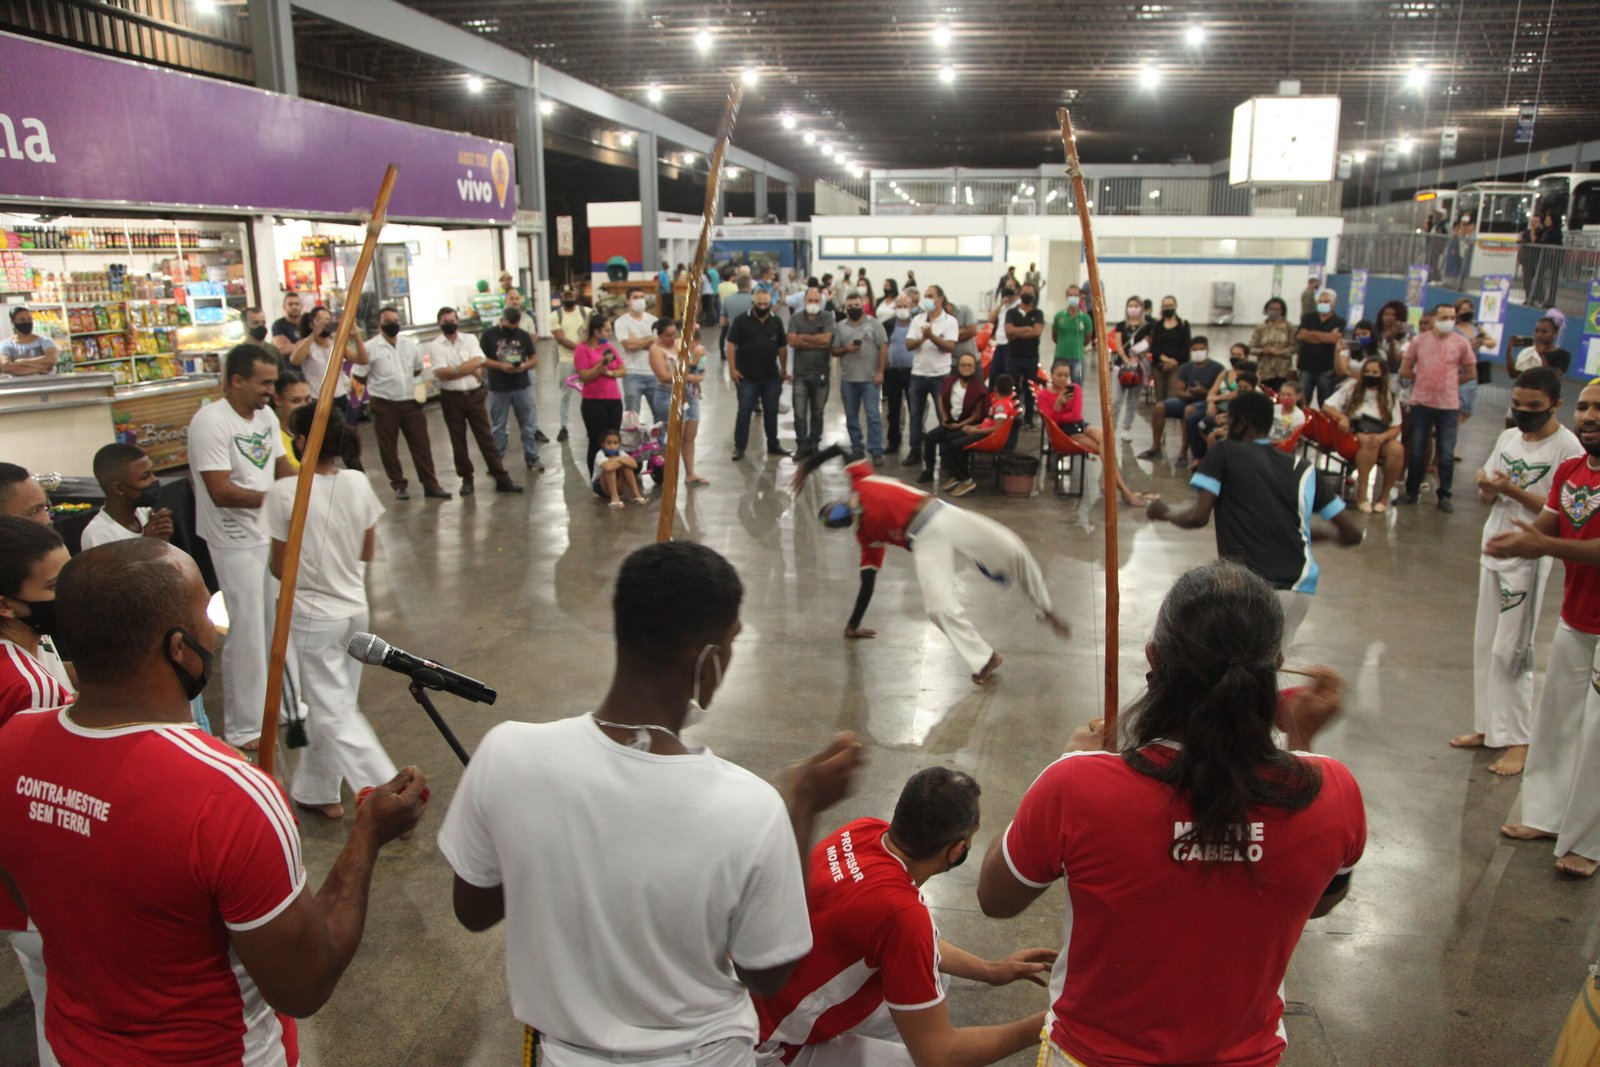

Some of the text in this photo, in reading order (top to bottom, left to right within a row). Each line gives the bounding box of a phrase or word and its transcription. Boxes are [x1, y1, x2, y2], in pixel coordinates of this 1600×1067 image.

[457, 169, 492, 204] vivo
[16, 775, 111, 822] CONTRA-MESTRE
[29, 801, 91, 837] SEM TERRA
[1172, 843, 1263, 862] CABELO
